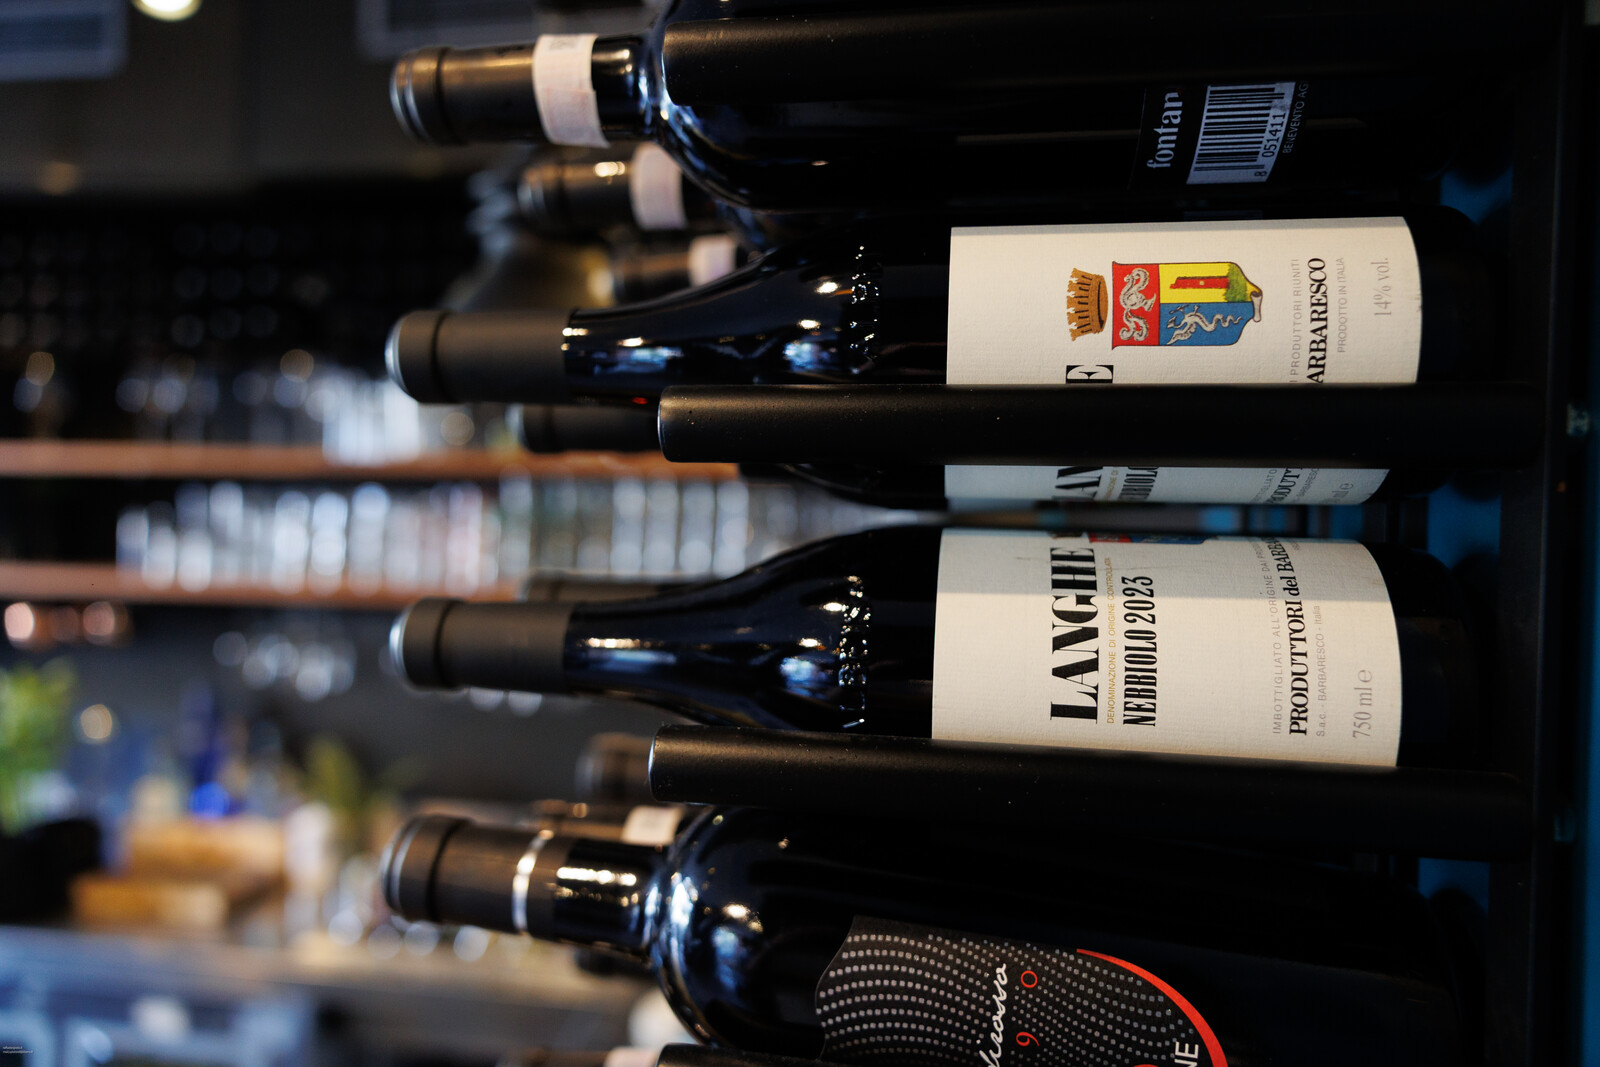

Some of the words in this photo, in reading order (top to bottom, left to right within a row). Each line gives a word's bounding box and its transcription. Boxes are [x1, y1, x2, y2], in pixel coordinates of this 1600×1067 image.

[1282, 101, 1305, 154] BENEVENTO
[1290, 259, 1302, 297] RIUNITI
[1335, 257, 1346, 283] ITALIA
[1338, 285, 1347, 295] IN
[1370, 257, 1391, 281] vol.
[1306, 257, 1328, 384] ARBARESCO
[1372, 285, 1392, 316] 14%
[1290, 300, 1302, 376] PRODUTTORI
[1337, 297, 1347, 353] PRODOTTO
[1104, 557, 1115, 601] CONTROLLATA
[1121, 576, 1156, 625] 2023
[1279, 575, 1300, 597] del
[1107, 603, 1116, 637] ORIGINE
[1264, 575, 1281, 638] ALL'ORIGINE
[1313, 605, 1322, 625] Italia
[1049, 547, 1099, 725] LANGHE
[1108, 639, 1116, 648] DI
[1106, 651, 1116, 724] DENOMINAZIONE
[1122, 629, 1157, 727] NEBBIOLO
[1273, 642, 1283, 735] IMBOTTIGLIATO
[1285, 599, 1308, 736] PRODUTTORI
[1315, 633, 1327, 701] BARBARESCO
[1353, 687, 1372, 707] ml
[1315, 711, 1326, 737] S.a.c.
[1352, 711, 1372, 739] 750
